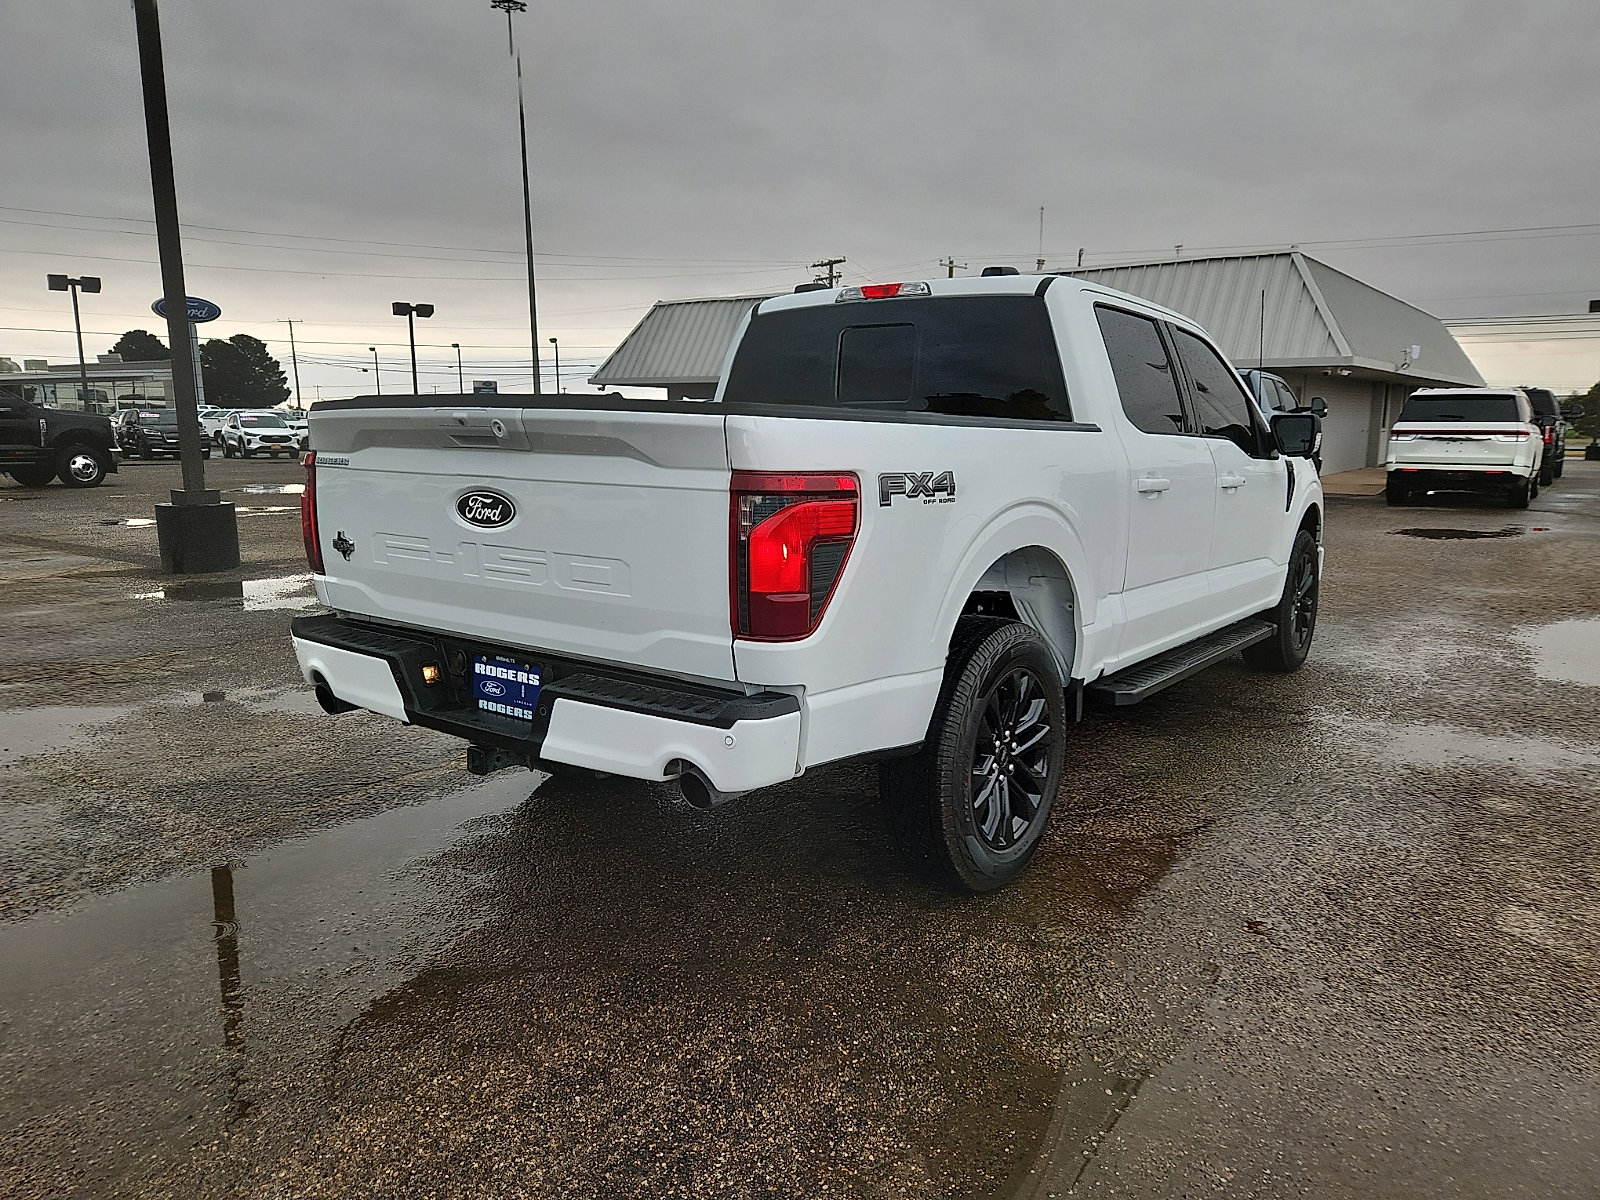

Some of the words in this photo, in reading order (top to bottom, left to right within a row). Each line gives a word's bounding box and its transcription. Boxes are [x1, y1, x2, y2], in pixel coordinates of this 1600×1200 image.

[878, 471, 956, 507] FX4
[465, 495, 503, 522] Ford
[372, 532, 632, 598] F-150
[474, 662, 540, 686] ROGERS
[484, 682, 502, 695] Ford
[478, 699, 533, 720] ROGERS
